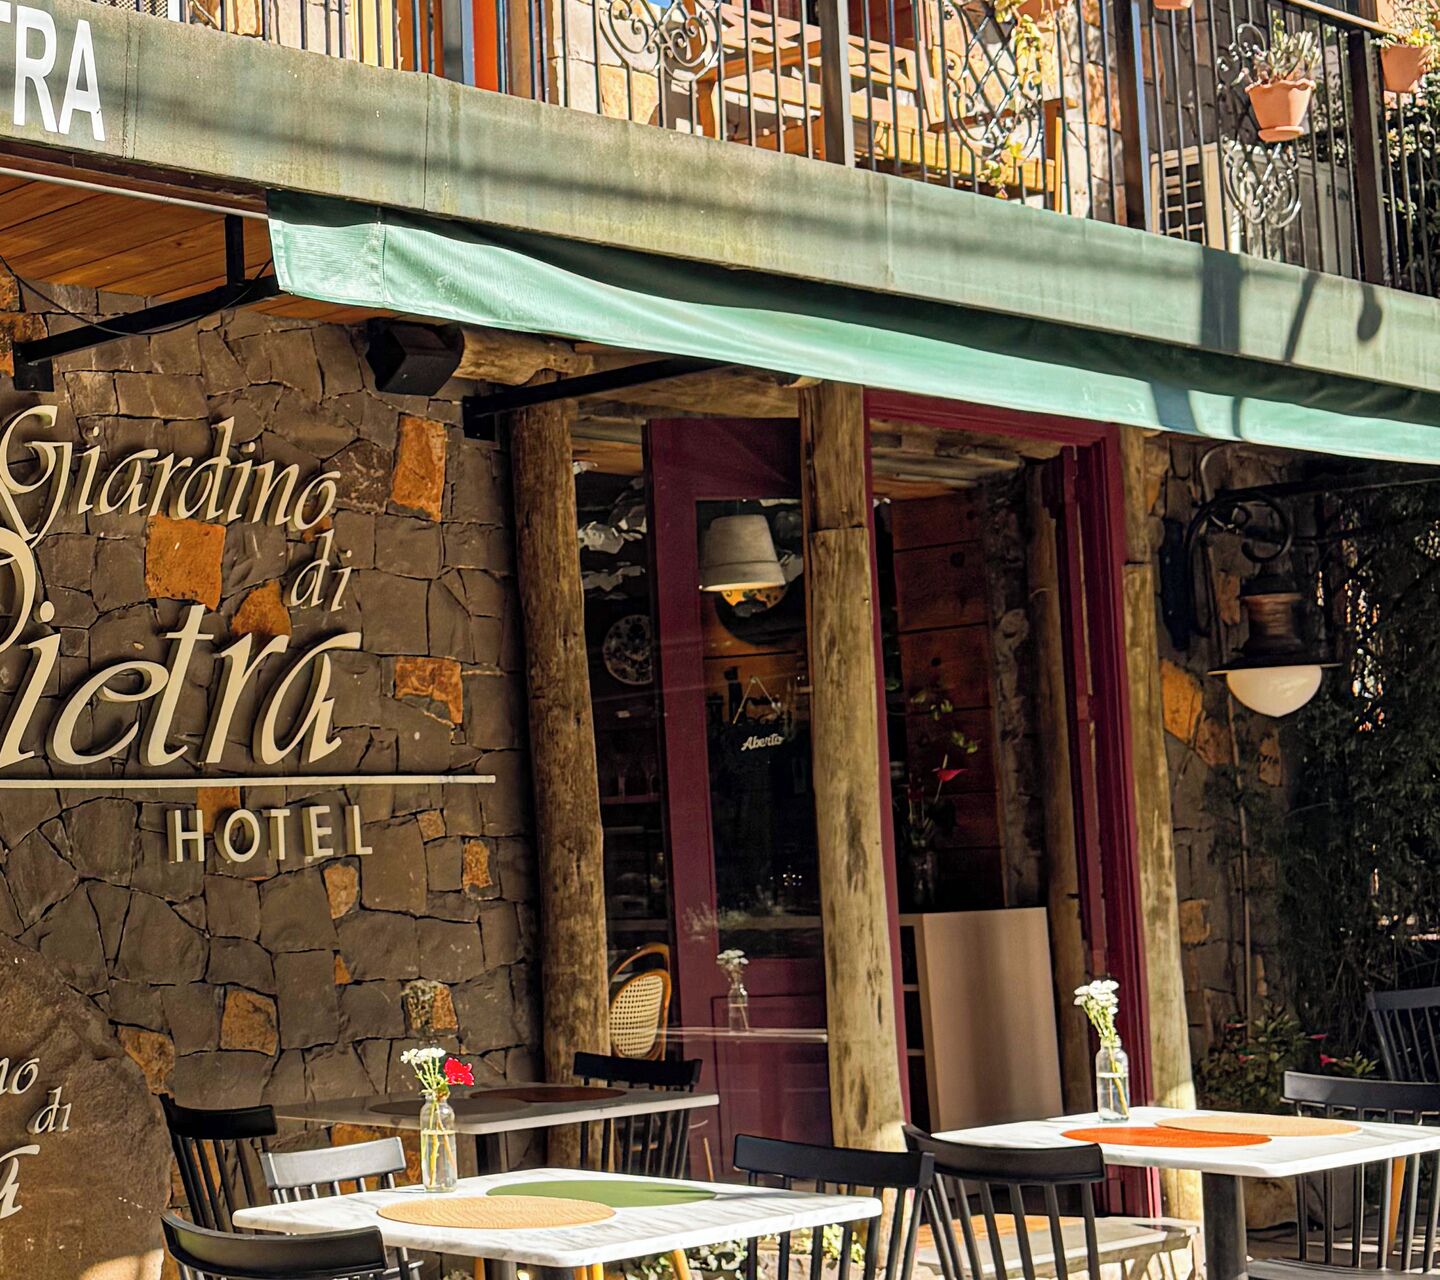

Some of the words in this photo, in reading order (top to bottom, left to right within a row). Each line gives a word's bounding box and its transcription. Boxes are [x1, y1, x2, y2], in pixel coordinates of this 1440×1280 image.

[289, 528, 353, 613] di
[740, 732, 786, 752] Aberto
[166, 803, 374, 863] HOTEL
[32, 1086, 72, 1133] di
